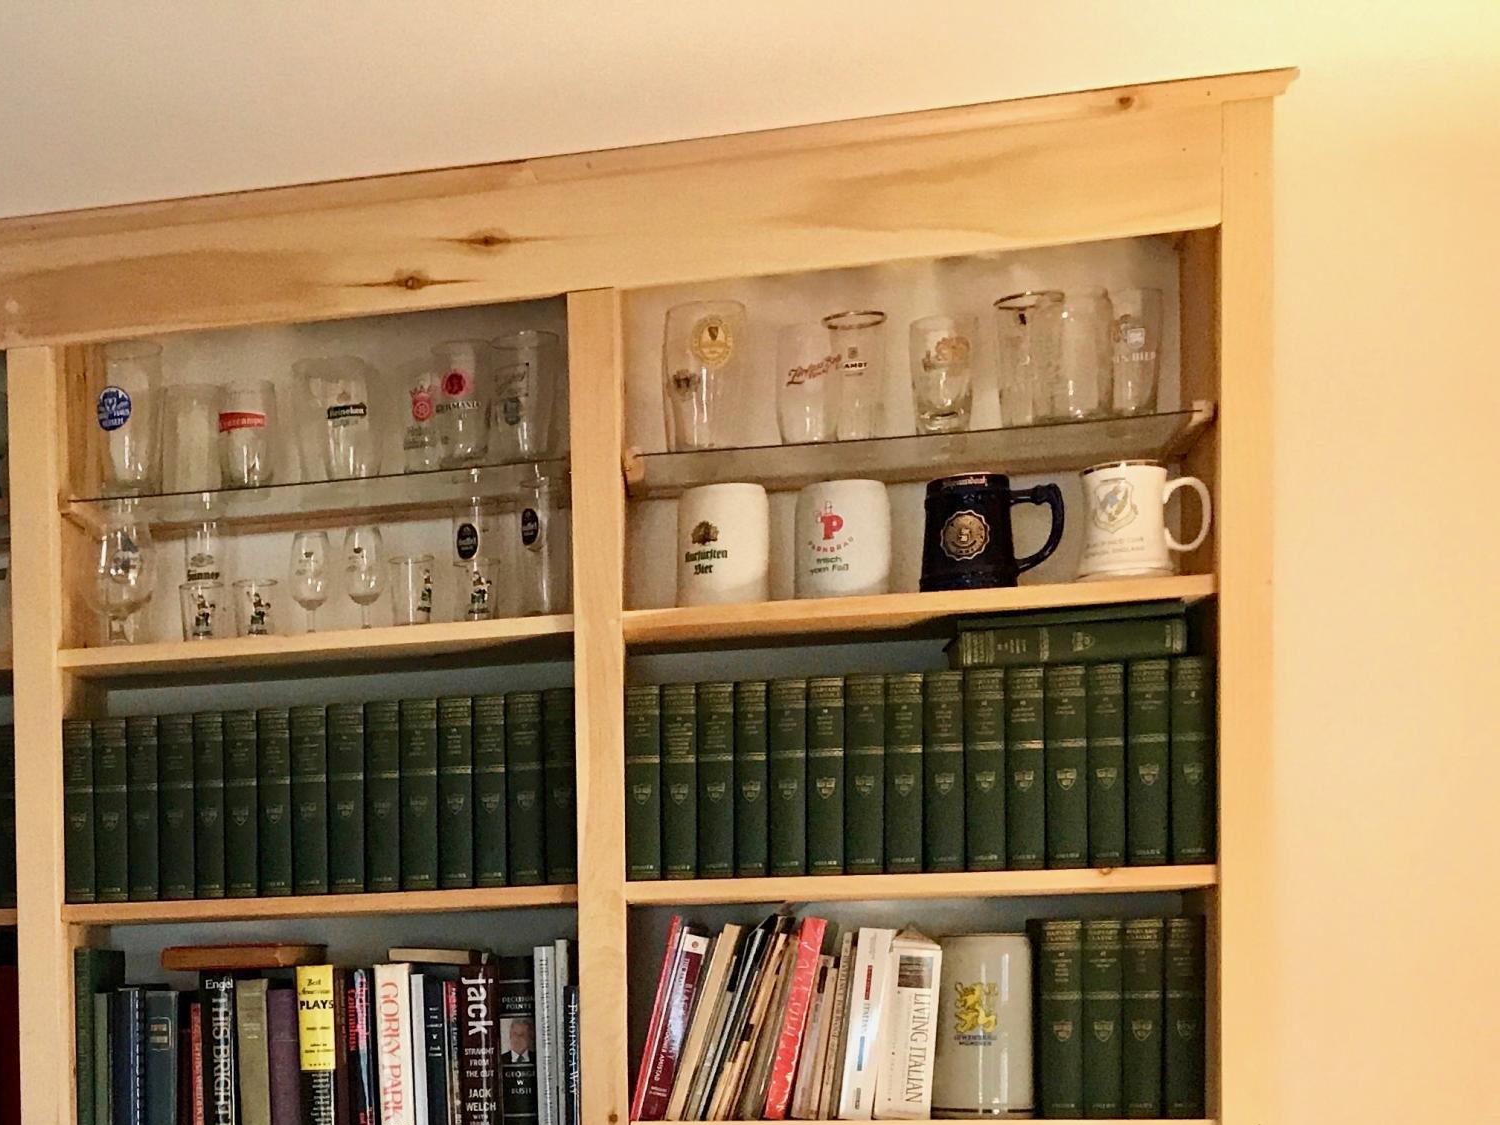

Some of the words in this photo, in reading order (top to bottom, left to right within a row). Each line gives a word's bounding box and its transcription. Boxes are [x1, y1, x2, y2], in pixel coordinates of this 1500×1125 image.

[205, 979, 234, 990] Engel
[212, 996, 231, 1039] THIS
[300, 999, 334, 1010] PLAYS
[379, 982, 401, 1057] GORKY
[461, 977, 494, 1035] jack
[910, 992, 931, 1042] LIVING
[568, 1004, 578, 1057] FINDING
[464, 1048, 494, 1056] STRAIGHT
[469, 1059, 490, 1067] FROM
[213, 1045, 232, 1119] BRIGHT
[466, 1070, 479, 1078] THE
[480, 1070, 494, 1078] GUT
[569, 1070, 580, 1095] WAY
[904, 1046, 927, 1103] ITALIAN
[382, 1064, 403, 1121] PARK
[466, 1102, 497, 1112] WELCH
[469, 1088, 493, 1098] JACK
